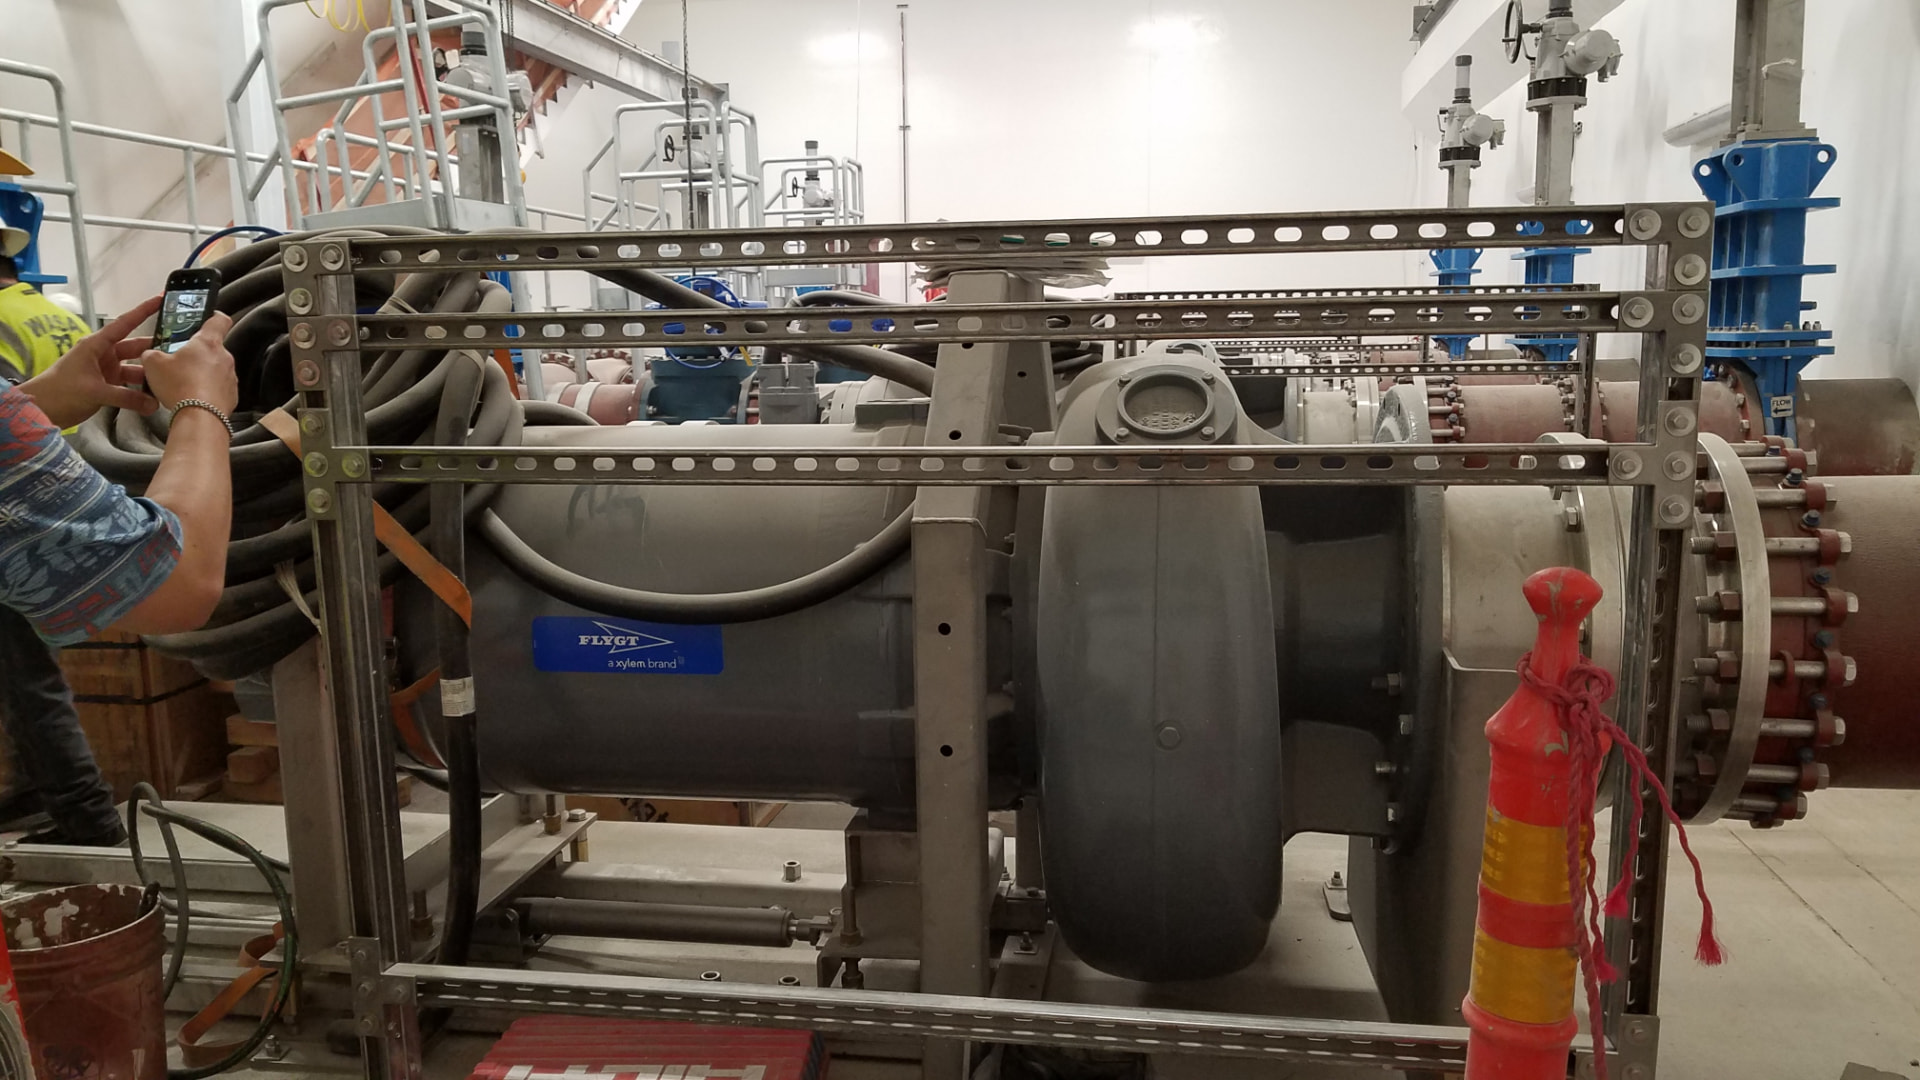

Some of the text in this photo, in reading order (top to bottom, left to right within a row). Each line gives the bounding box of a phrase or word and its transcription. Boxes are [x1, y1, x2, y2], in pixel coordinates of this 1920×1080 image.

[578, 635, 640, 646] FLYGT
[608, 658, 677, 670] a xylem brand
